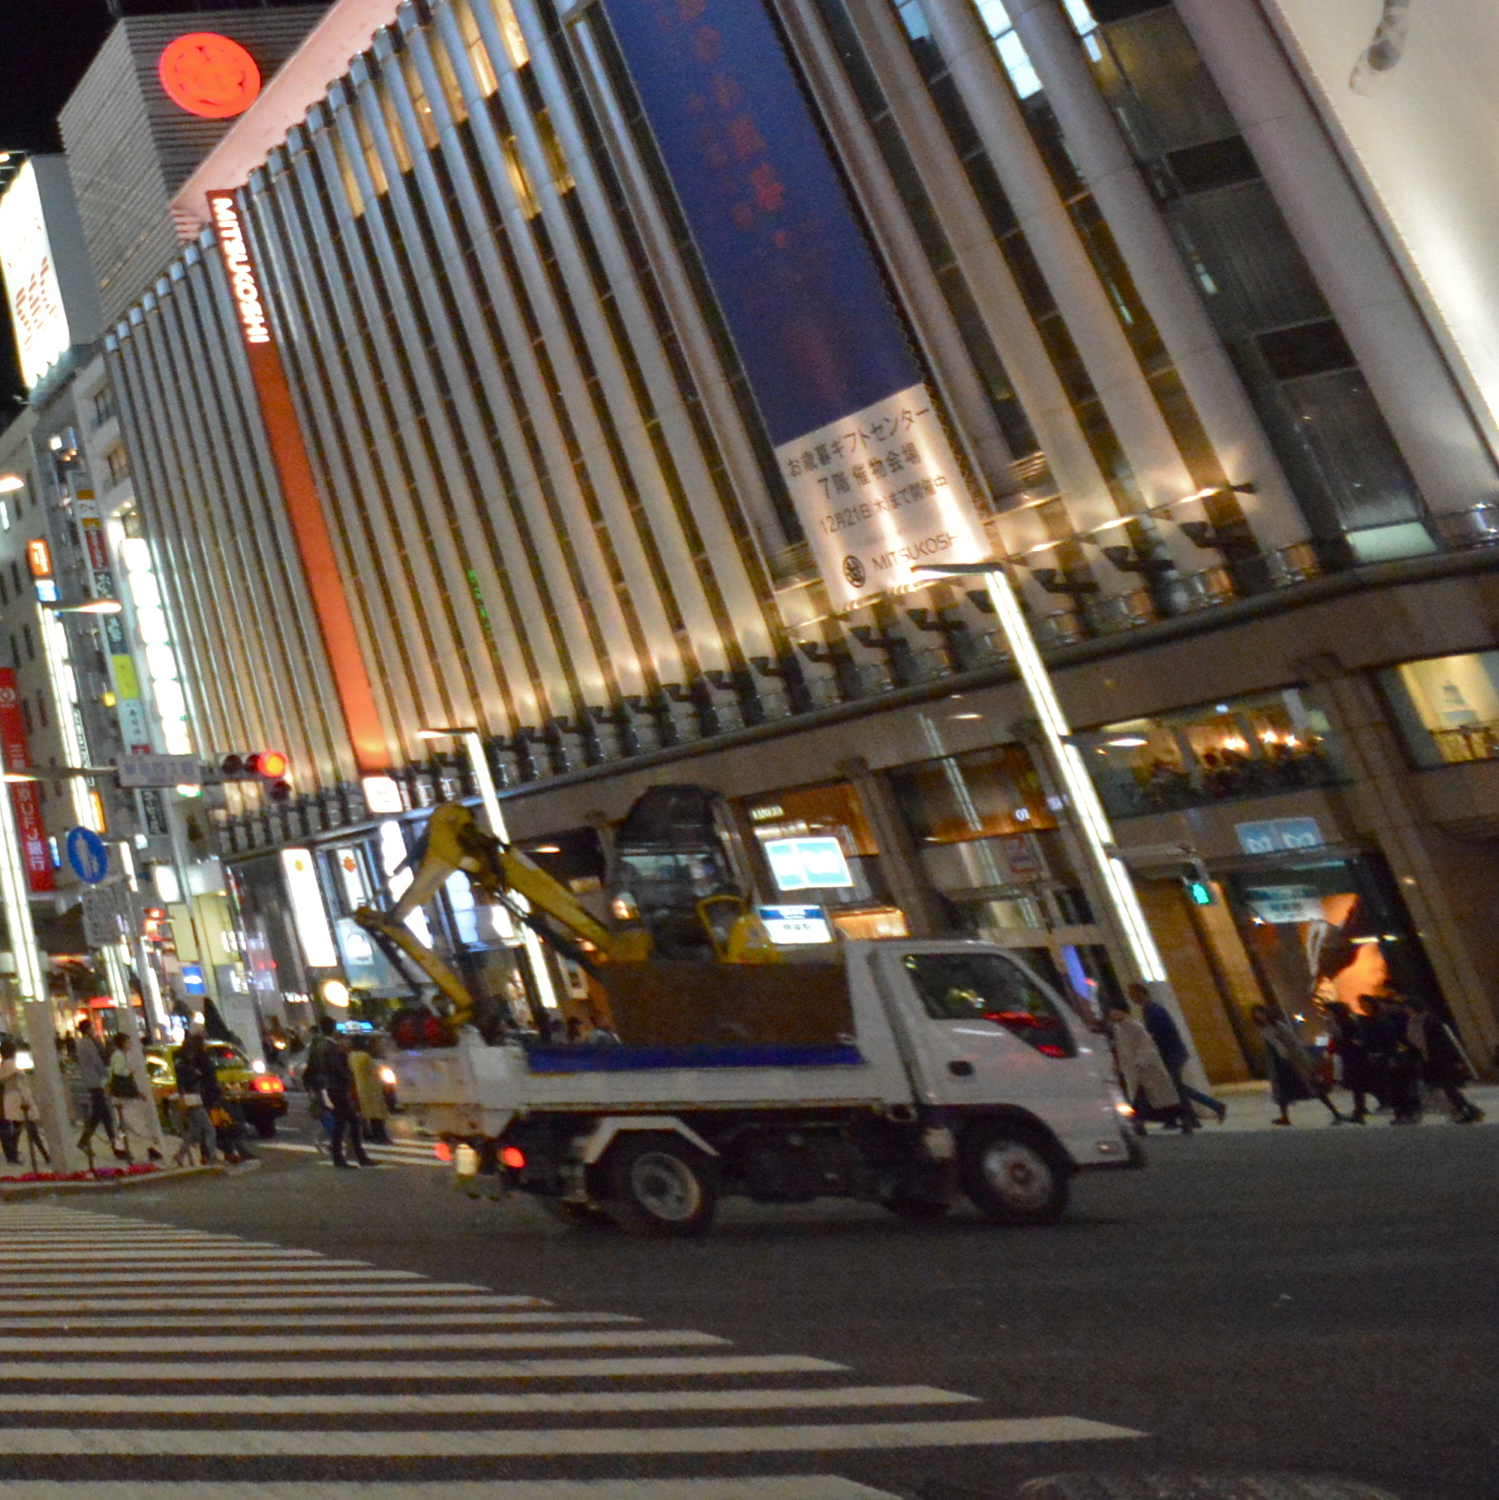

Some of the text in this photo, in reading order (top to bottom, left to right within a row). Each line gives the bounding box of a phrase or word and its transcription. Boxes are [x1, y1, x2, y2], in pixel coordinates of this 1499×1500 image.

[212, 197, 271, 344] MITSUKOSHI
[787, 407, 931, 479] お歳暮ギフトセンター
[870, 531, 959, 573] MITSUKOSH
